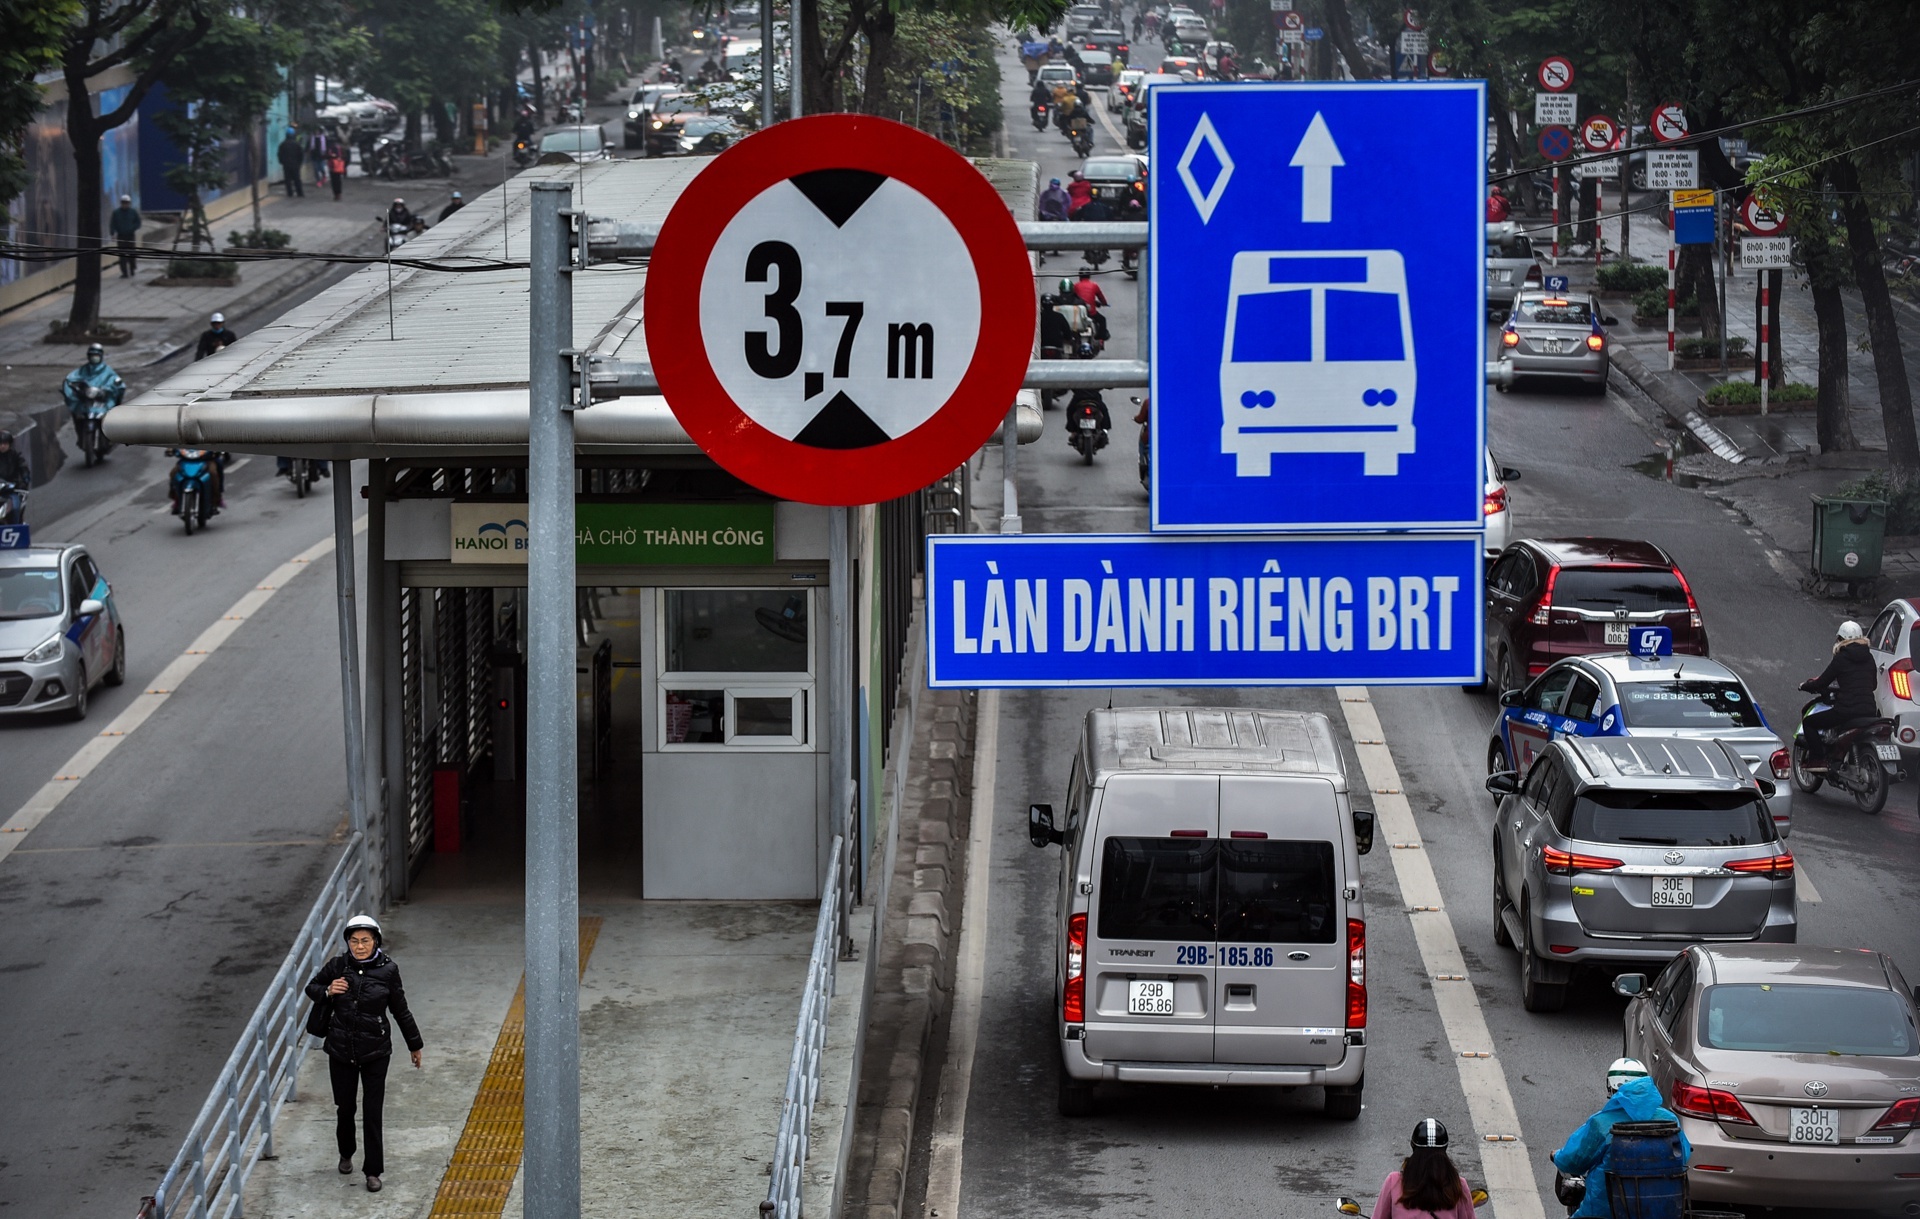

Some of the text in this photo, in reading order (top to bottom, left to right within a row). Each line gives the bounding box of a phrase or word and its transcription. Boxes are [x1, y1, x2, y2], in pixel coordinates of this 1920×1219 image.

[1747, 242, 1763, 251] 6h00
[1770, 242, 1785, 251] 9h00
[1743, 256, 1763, 264] 16h30
[1770, 255, 1790, 264] 19h30
[1550, 278, 1562, 289] G7
[887, 323, 933, 379] m
[1, 528, 20, 547] G7
[600, 528, 636, 545] CHỜ
[643, 526, 707, 545] THÀNH
[712, 526, 764, 546] CÔNG
[455, 538, 508, 550] HANOI
[954, 561, 1047, 653] LÀN
[1064, 560, 1194, 652] DÀNH
[1209, 560, 1352, 652] RIÊNG
[1368, 577, 1458, 651] BRT
[1641, 631, 1662, 653] G7
[1662, 878, 1684, 890] 30E
[1654, 892, 1692, 904] 894.90
[1108, 949, 1155, 957] TRANSIT
[1140, 983, 1163, 997] 29B
[1132, 998, 1172, 1012] 185.86
[1800, 1110, 1829, 1125] 30H
[1795, 1126, 1833, 1142] 8892
